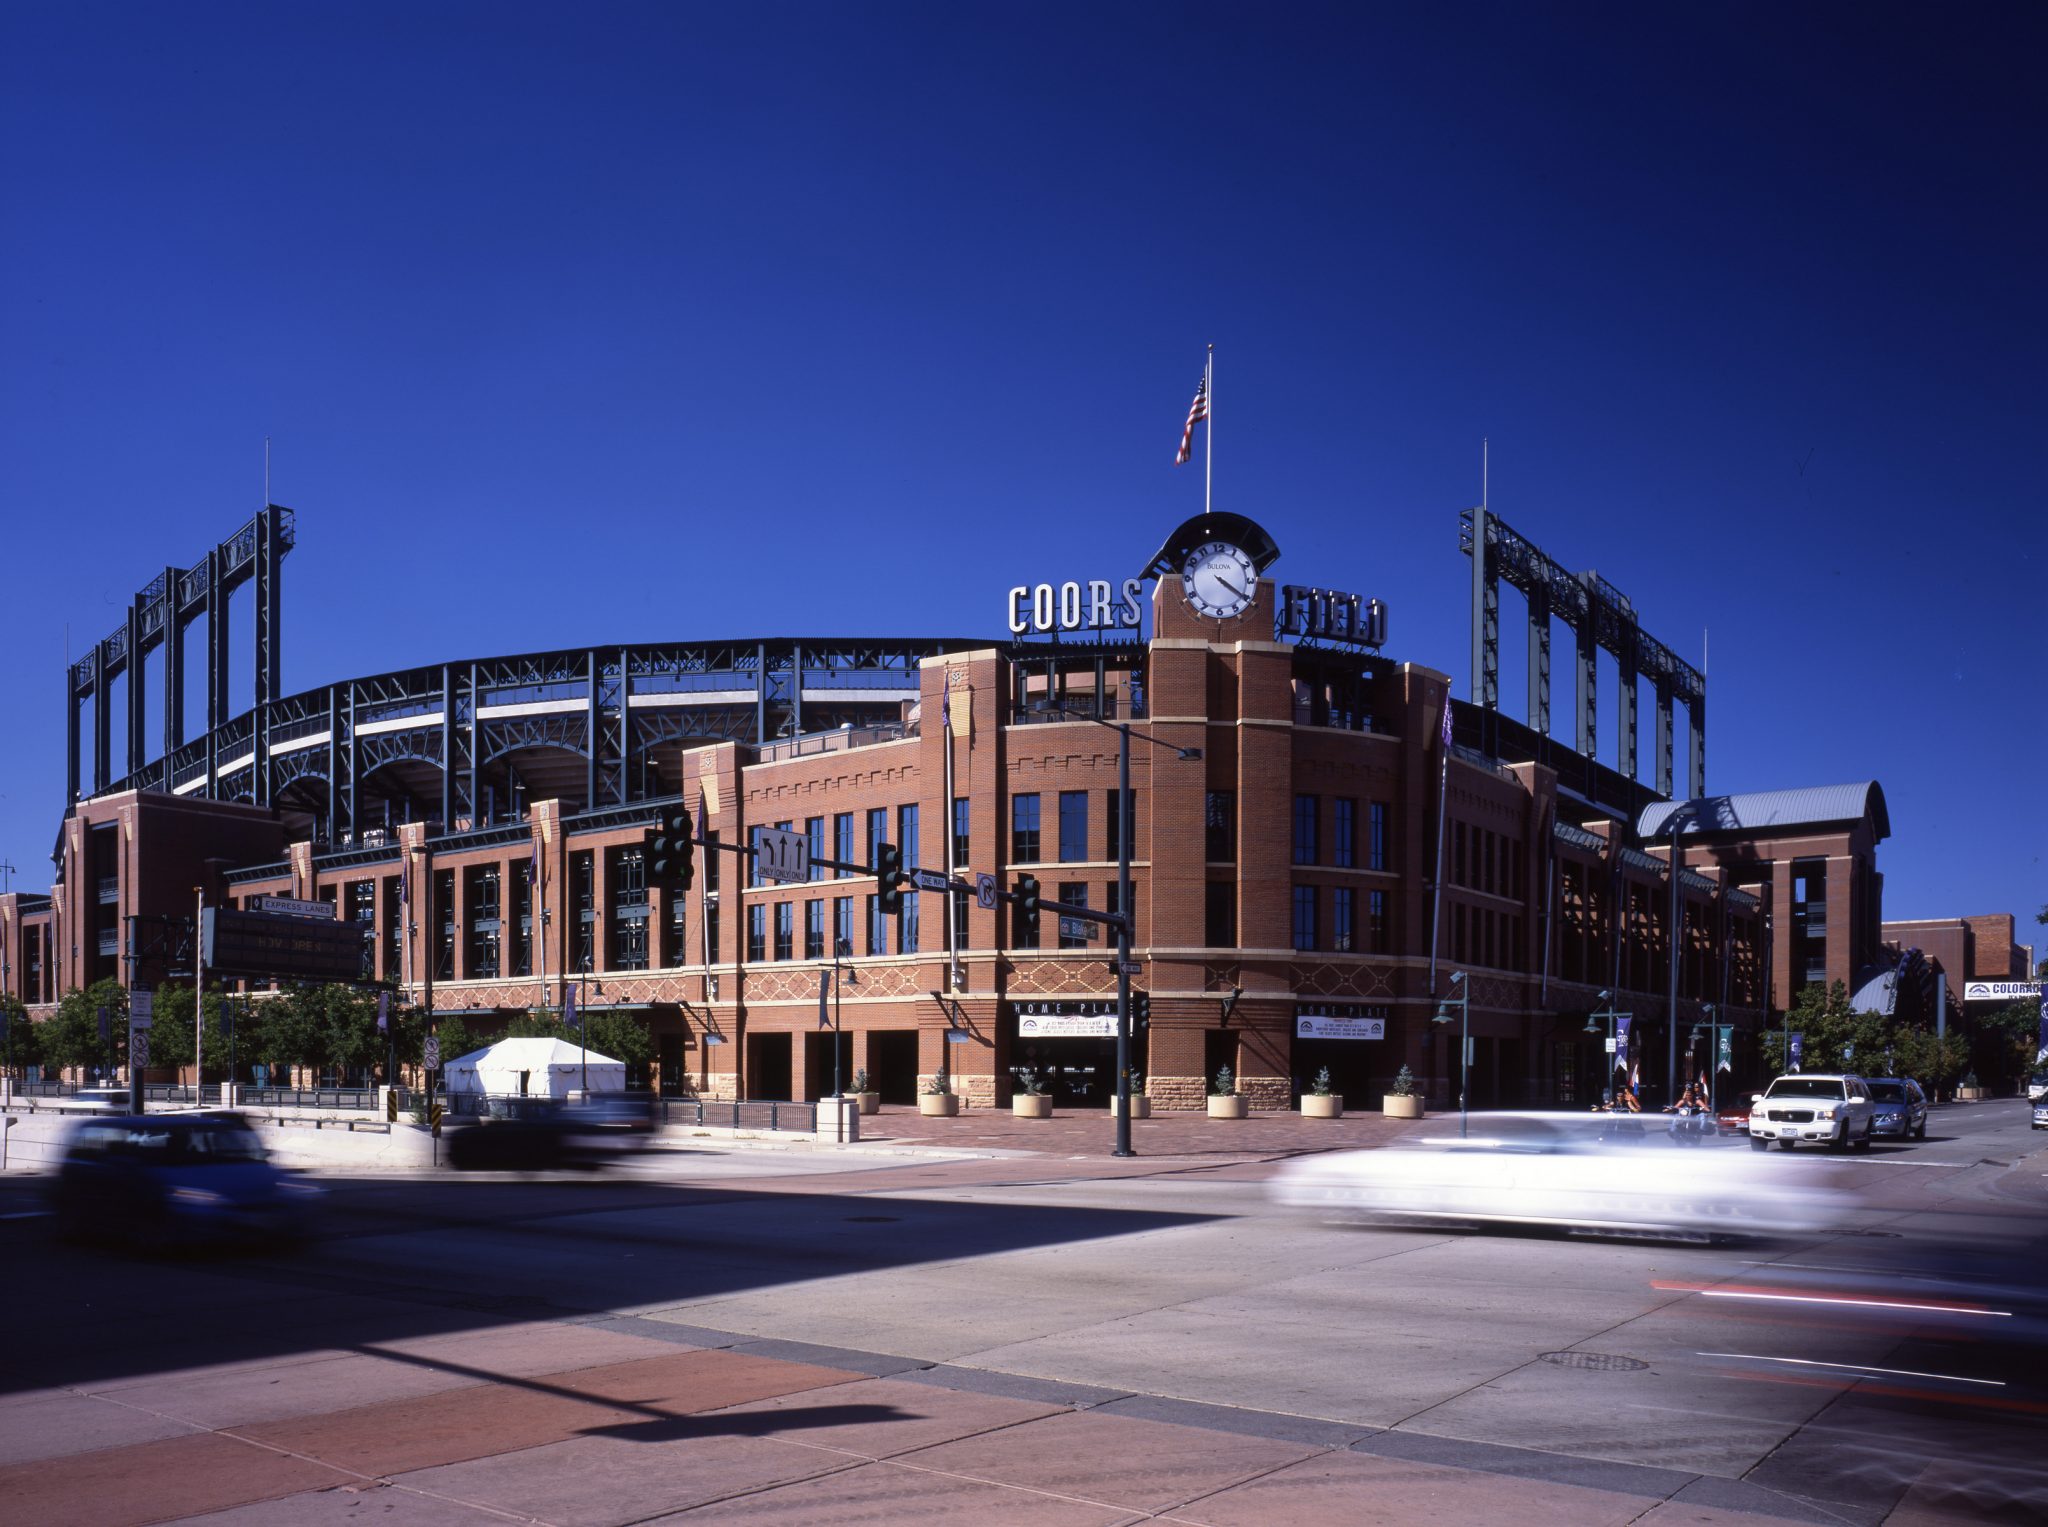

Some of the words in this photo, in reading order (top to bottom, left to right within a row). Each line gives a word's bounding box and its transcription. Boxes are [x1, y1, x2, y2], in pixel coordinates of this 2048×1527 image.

[1198, 548, 1208, 556] 11
[1188, 557, 1197, 568] 10
[1008, 578, 1142, 634] COORS
[1282, 585, 1388, 646] FIELD
[760, 867, 773, 876] ONLY
[776, 869, 789, 879] ONLY
[792, 871, 805, 880] ONLY
[922, 875, 932, 885] ONE
[933, 878, 945, 887] WAY
[265, 900, 302, 911] EXPRESS
[305, 905, 330, 914] LANES
[1993, 983, 2041, 994] COLORAD
[1015, 1003, 1060, 1013] HOME
[1297, 1006, 1336, 1016] HOME
